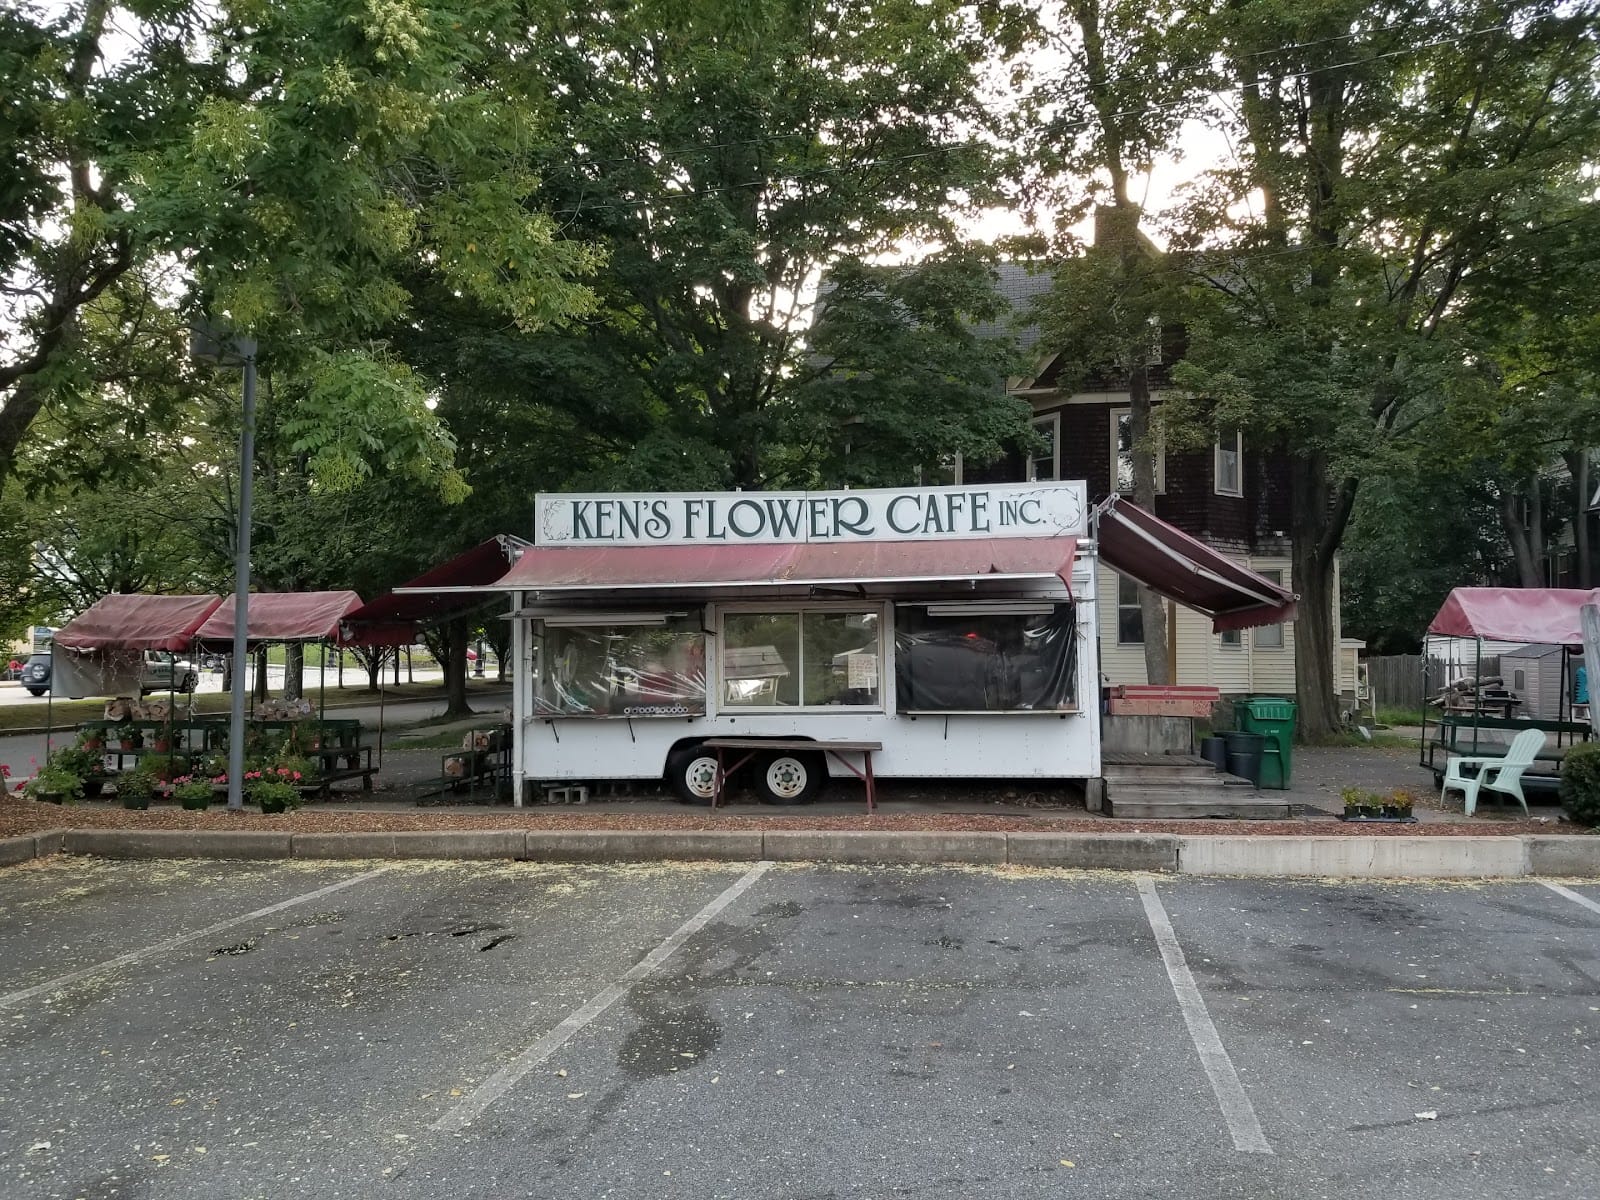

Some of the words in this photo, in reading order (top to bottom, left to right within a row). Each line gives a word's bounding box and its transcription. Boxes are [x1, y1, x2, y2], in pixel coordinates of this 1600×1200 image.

[571, 500, 671, 540] KEN'S
[682, 497, 875, 540] FLOWER
[886, 492, 990, 534] CAFE
[999, 500, 1047, 526] INC.
